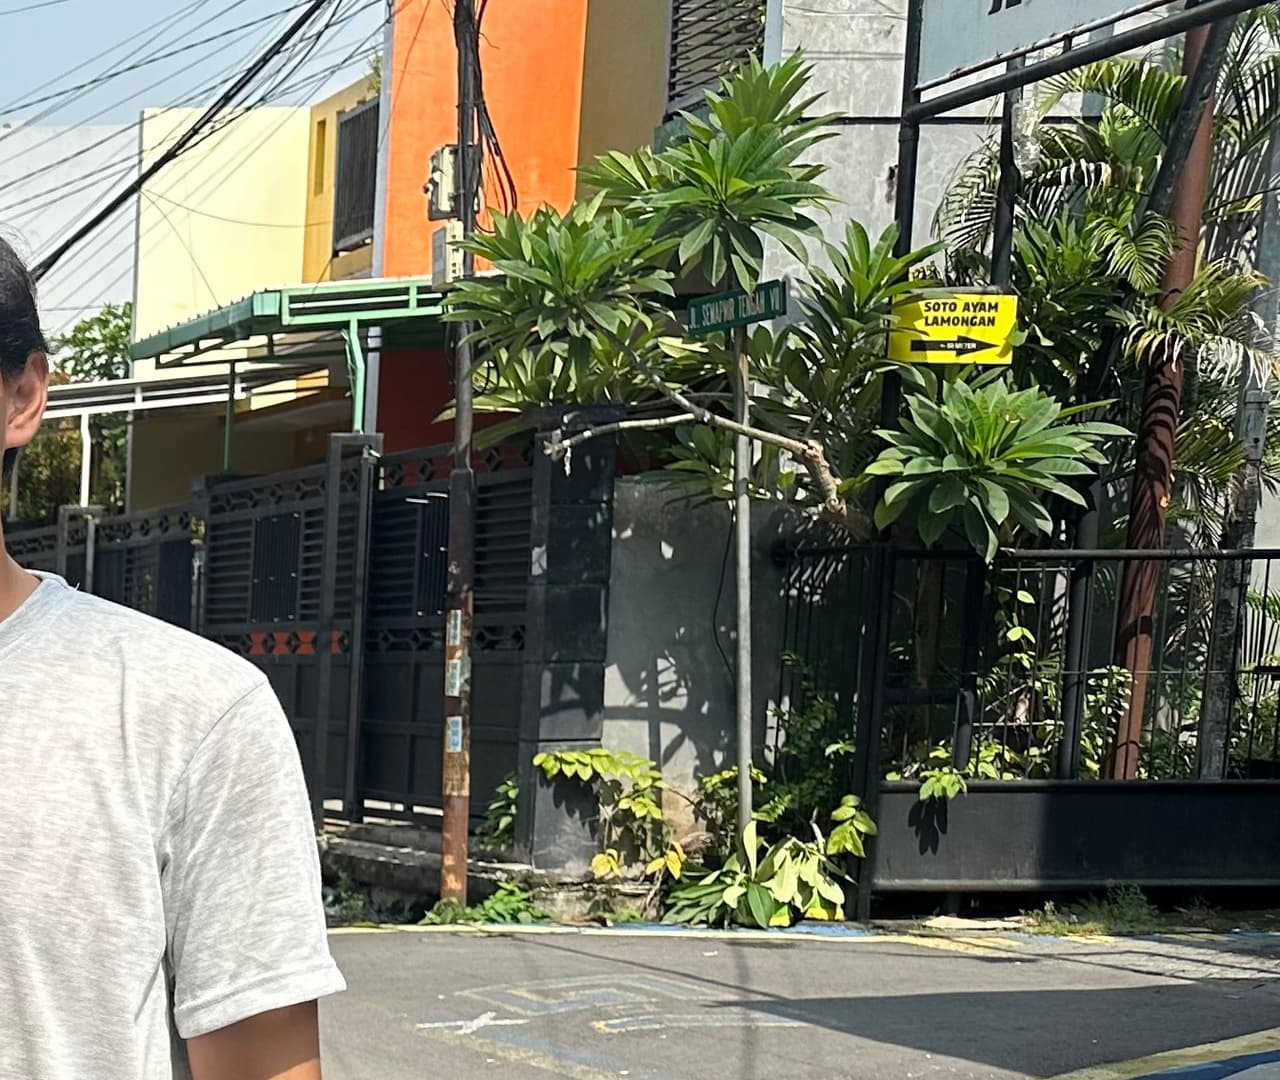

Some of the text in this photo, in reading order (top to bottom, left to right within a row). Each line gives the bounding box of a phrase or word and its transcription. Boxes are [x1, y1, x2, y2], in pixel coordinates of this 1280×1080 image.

[924, 302, 999, 313] SOTO AYAM
[924, 316, 996, 327] LAMONGAN
